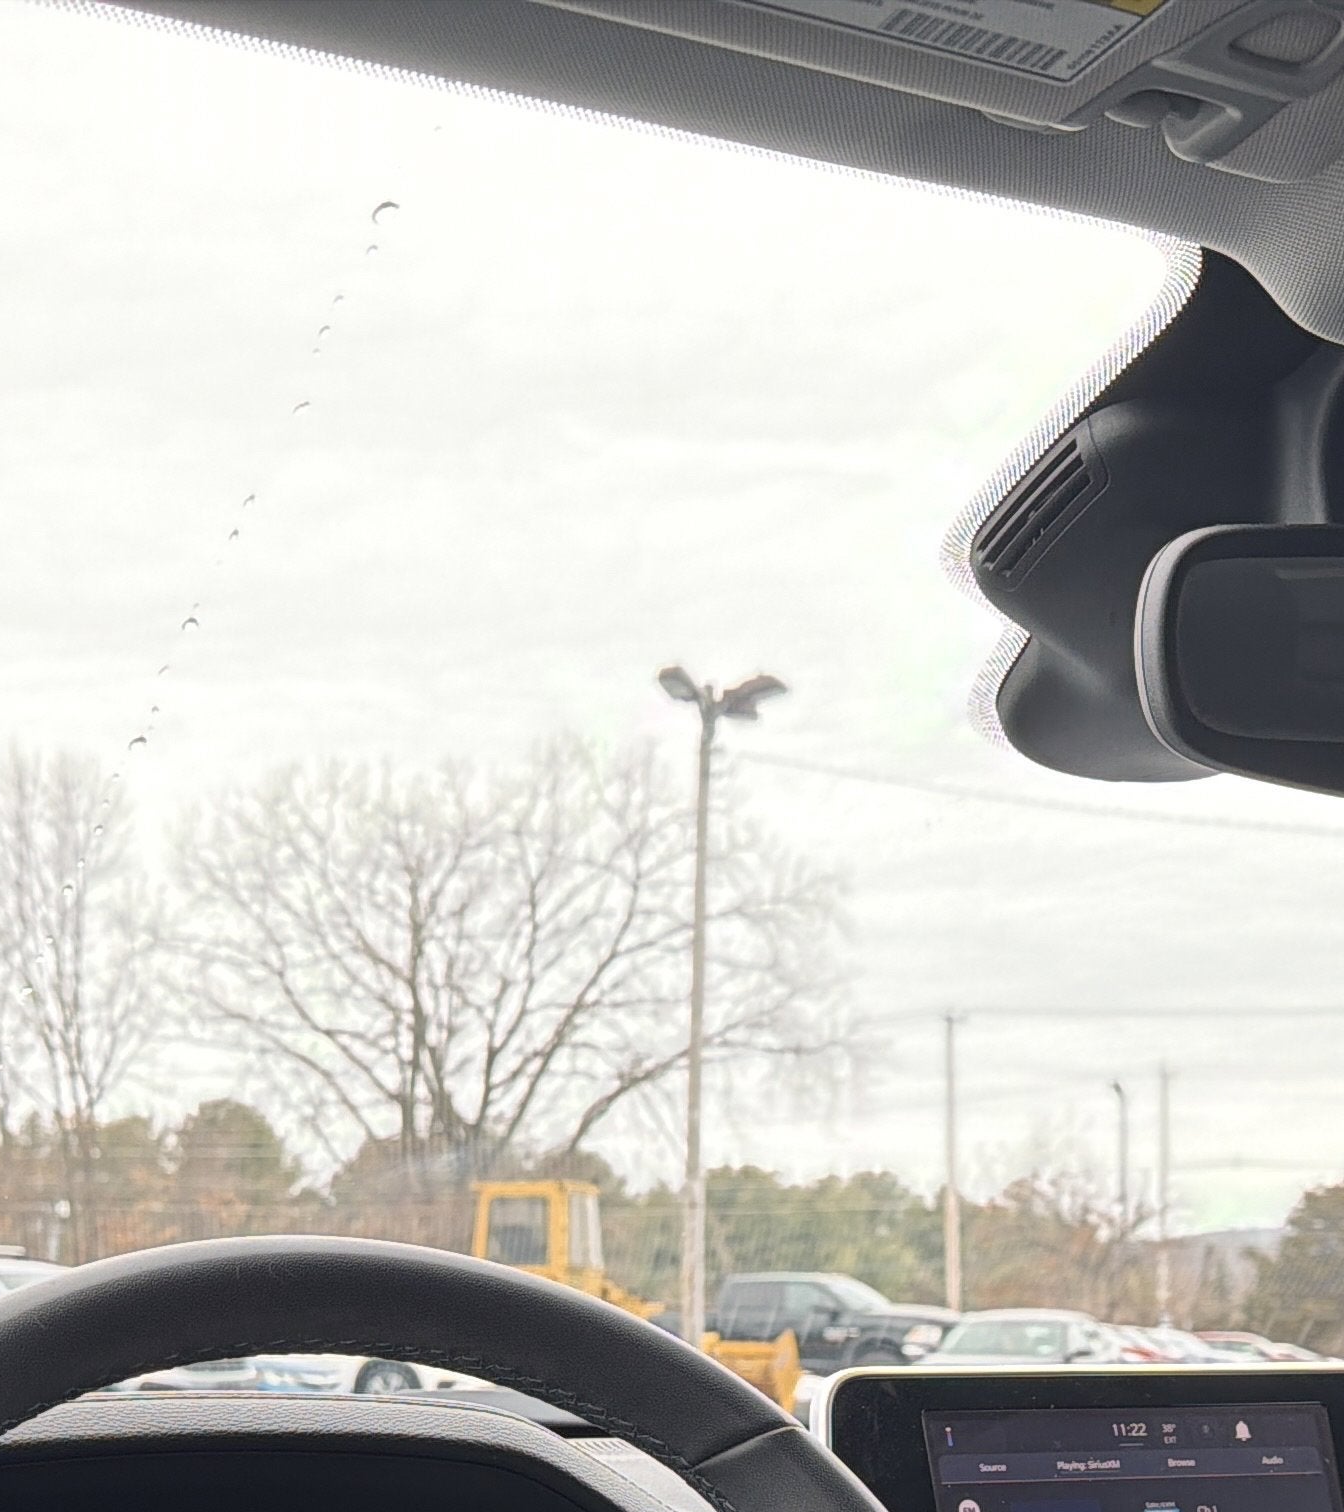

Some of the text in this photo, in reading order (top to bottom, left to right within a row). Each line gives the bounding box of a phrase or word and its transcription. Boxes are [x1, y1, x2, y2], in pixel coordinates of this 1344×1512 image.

[1112, 1423, 1147, 1437] 11:22
[1167, 1458, 1196, 1468] Browse
[1262, 1455, 1284, 1466] Audio
[979, 1463, 1007, 1473] Source
